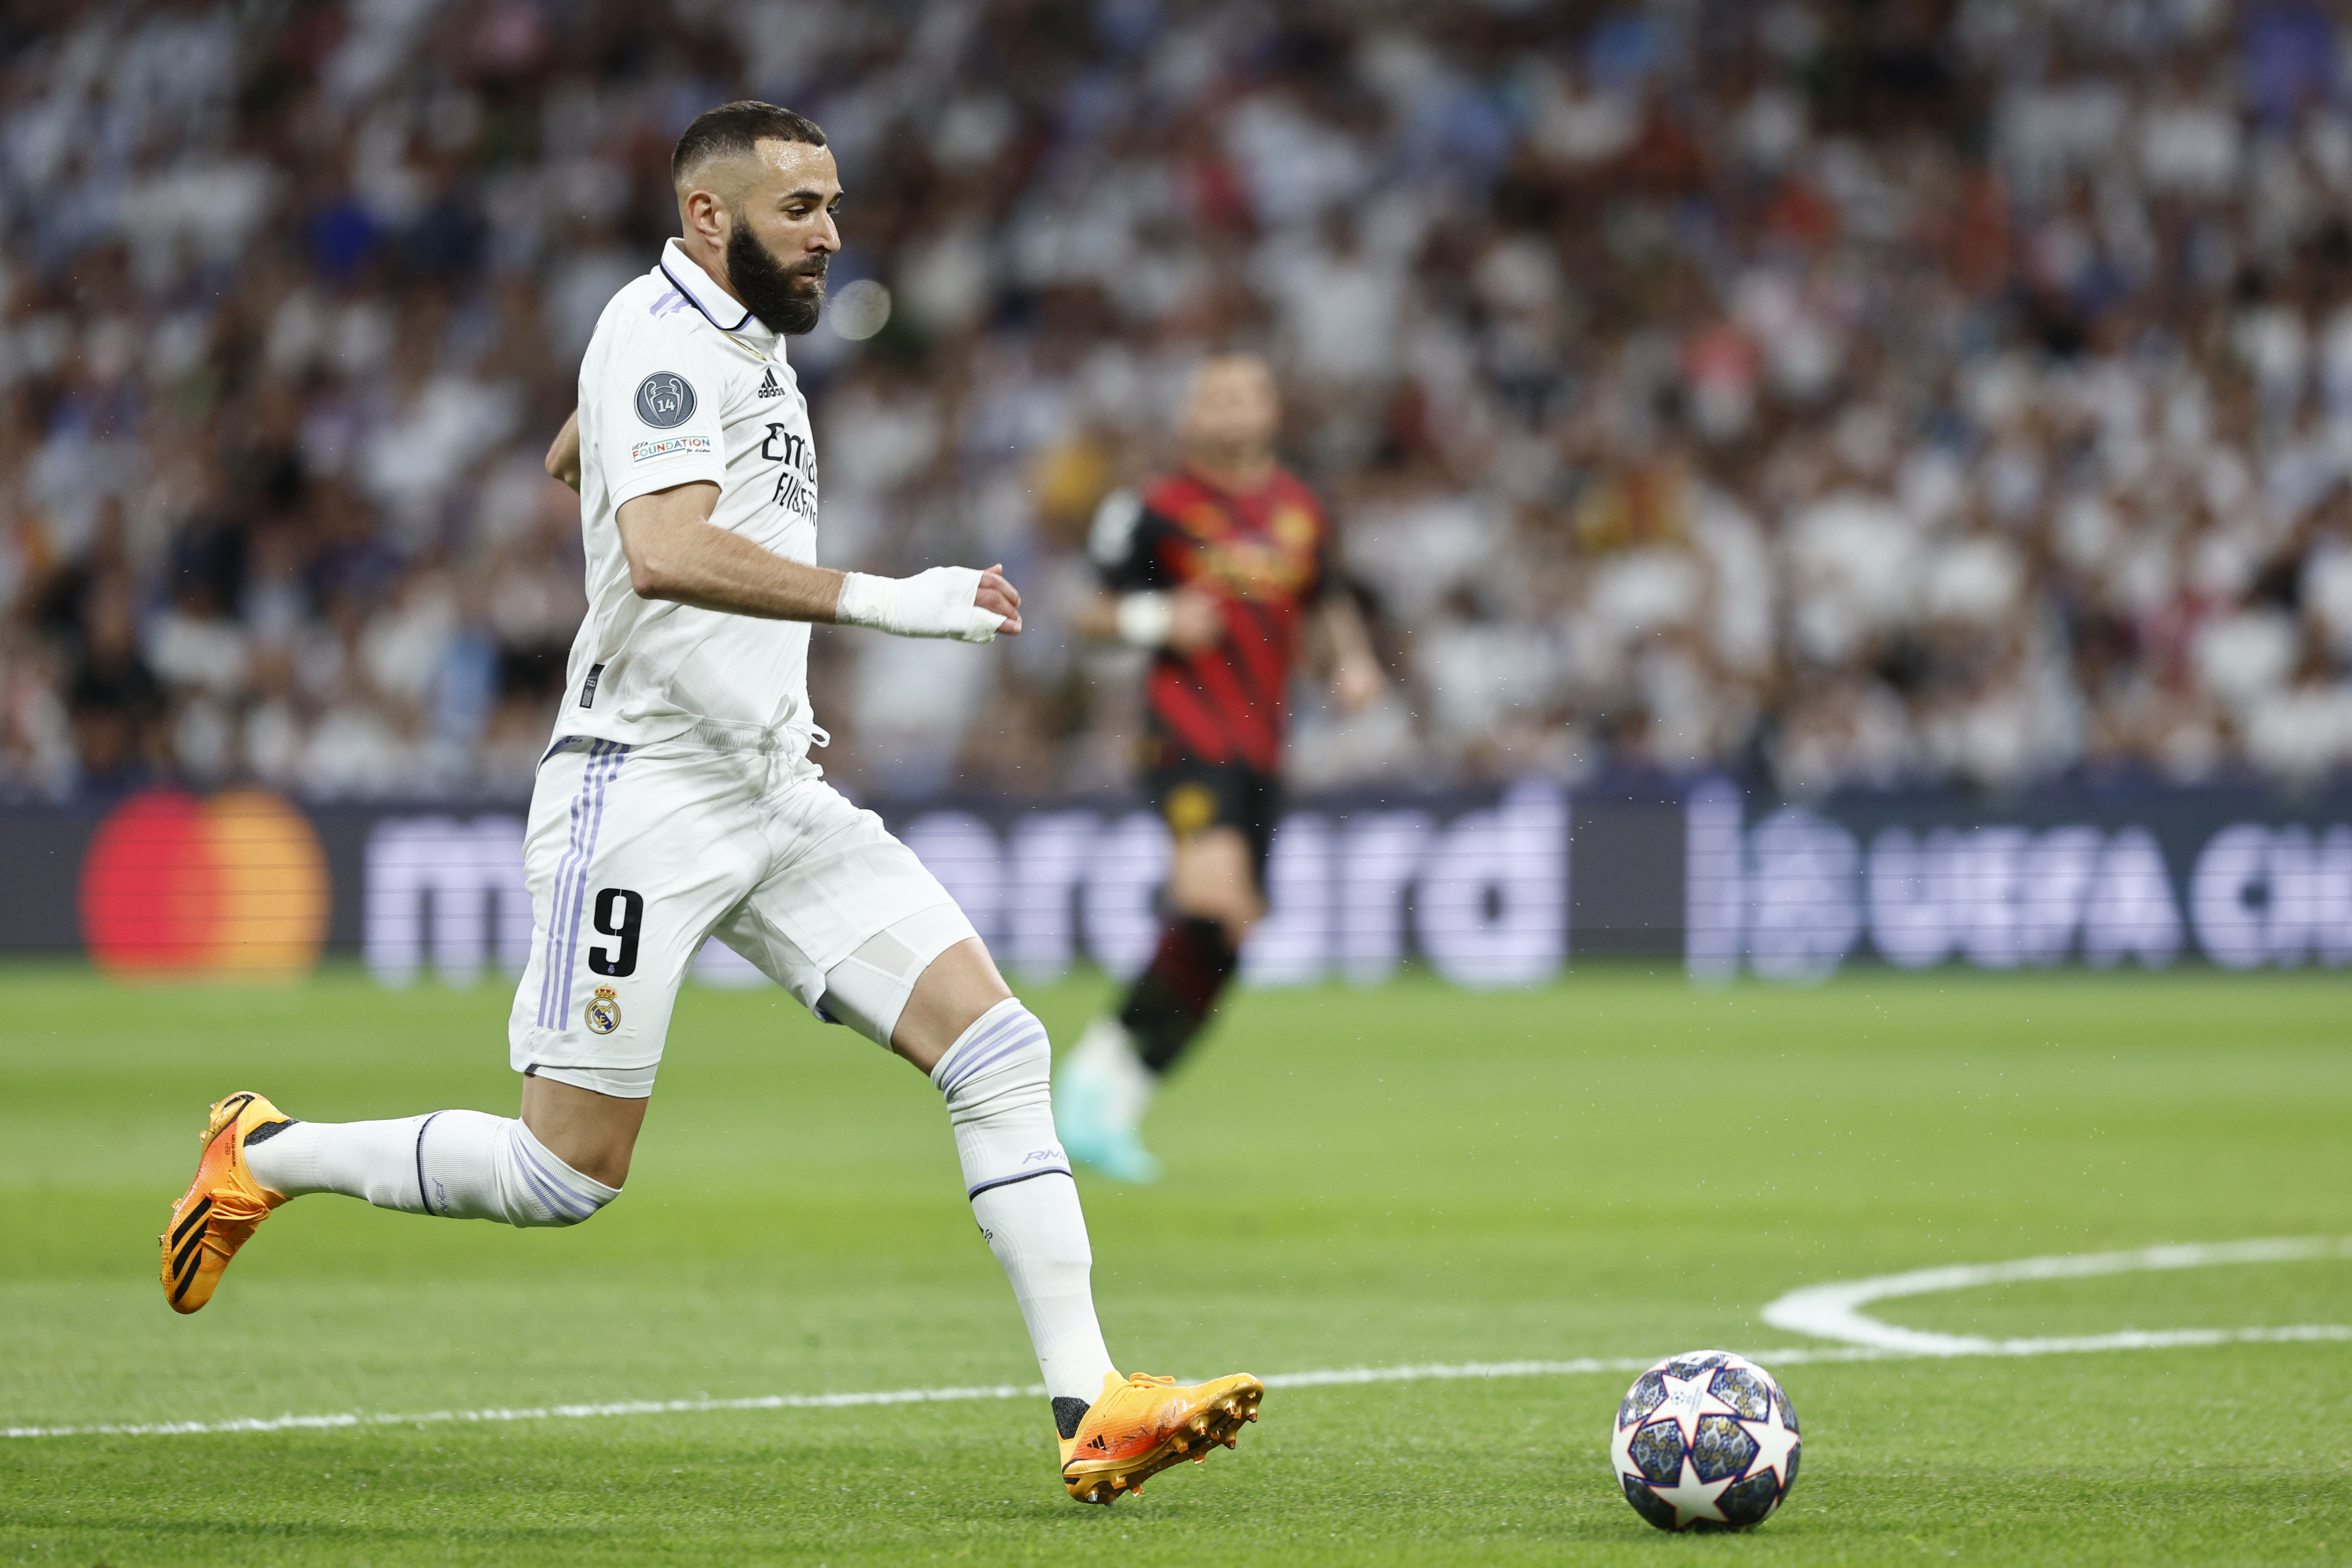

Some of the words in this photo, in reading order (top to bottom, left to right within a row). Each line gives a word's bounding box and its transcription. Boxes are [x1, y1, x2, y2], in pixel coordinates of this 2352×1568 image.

[758, 387, 785, 398] adidas
[657, 399, 675, 413] 14
[632, 442, 648, 450] UEFA
[633, 439, 710, 459] FOUNDATION
[588, 887, 643, 977] 9
